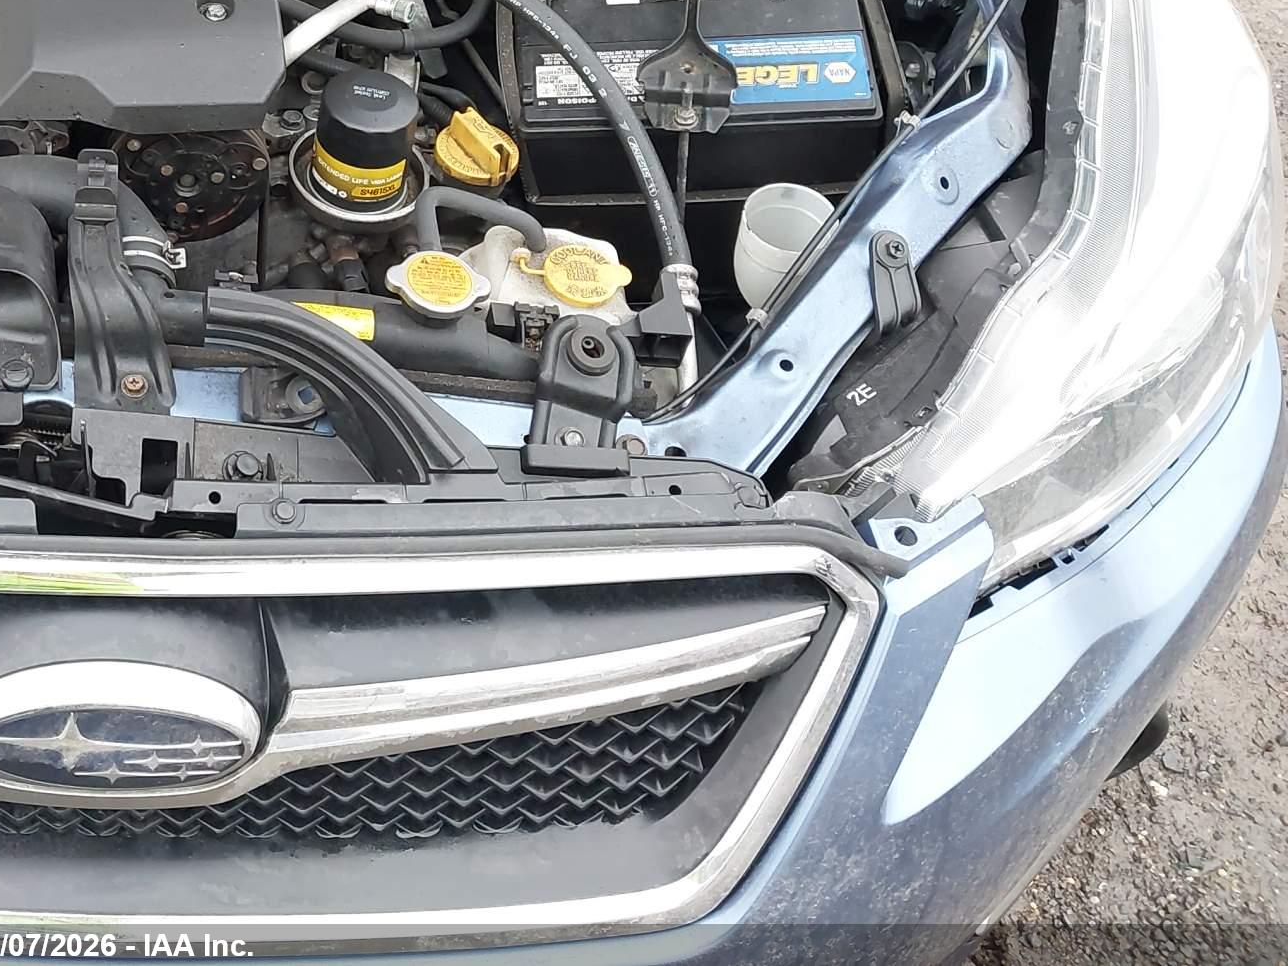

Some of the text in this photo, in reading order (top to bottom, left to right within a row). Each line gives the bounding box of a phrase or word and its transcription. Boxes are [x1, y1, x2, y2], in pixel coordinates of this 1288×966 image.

[736, 64, 818, 85] LEGE
[828, 68, 850, 77] NAPA
[351, 177, 369, 185] LIFE
[360, 184, 396, 196] S4615XL
[846, 383, 877, 406] 2E
